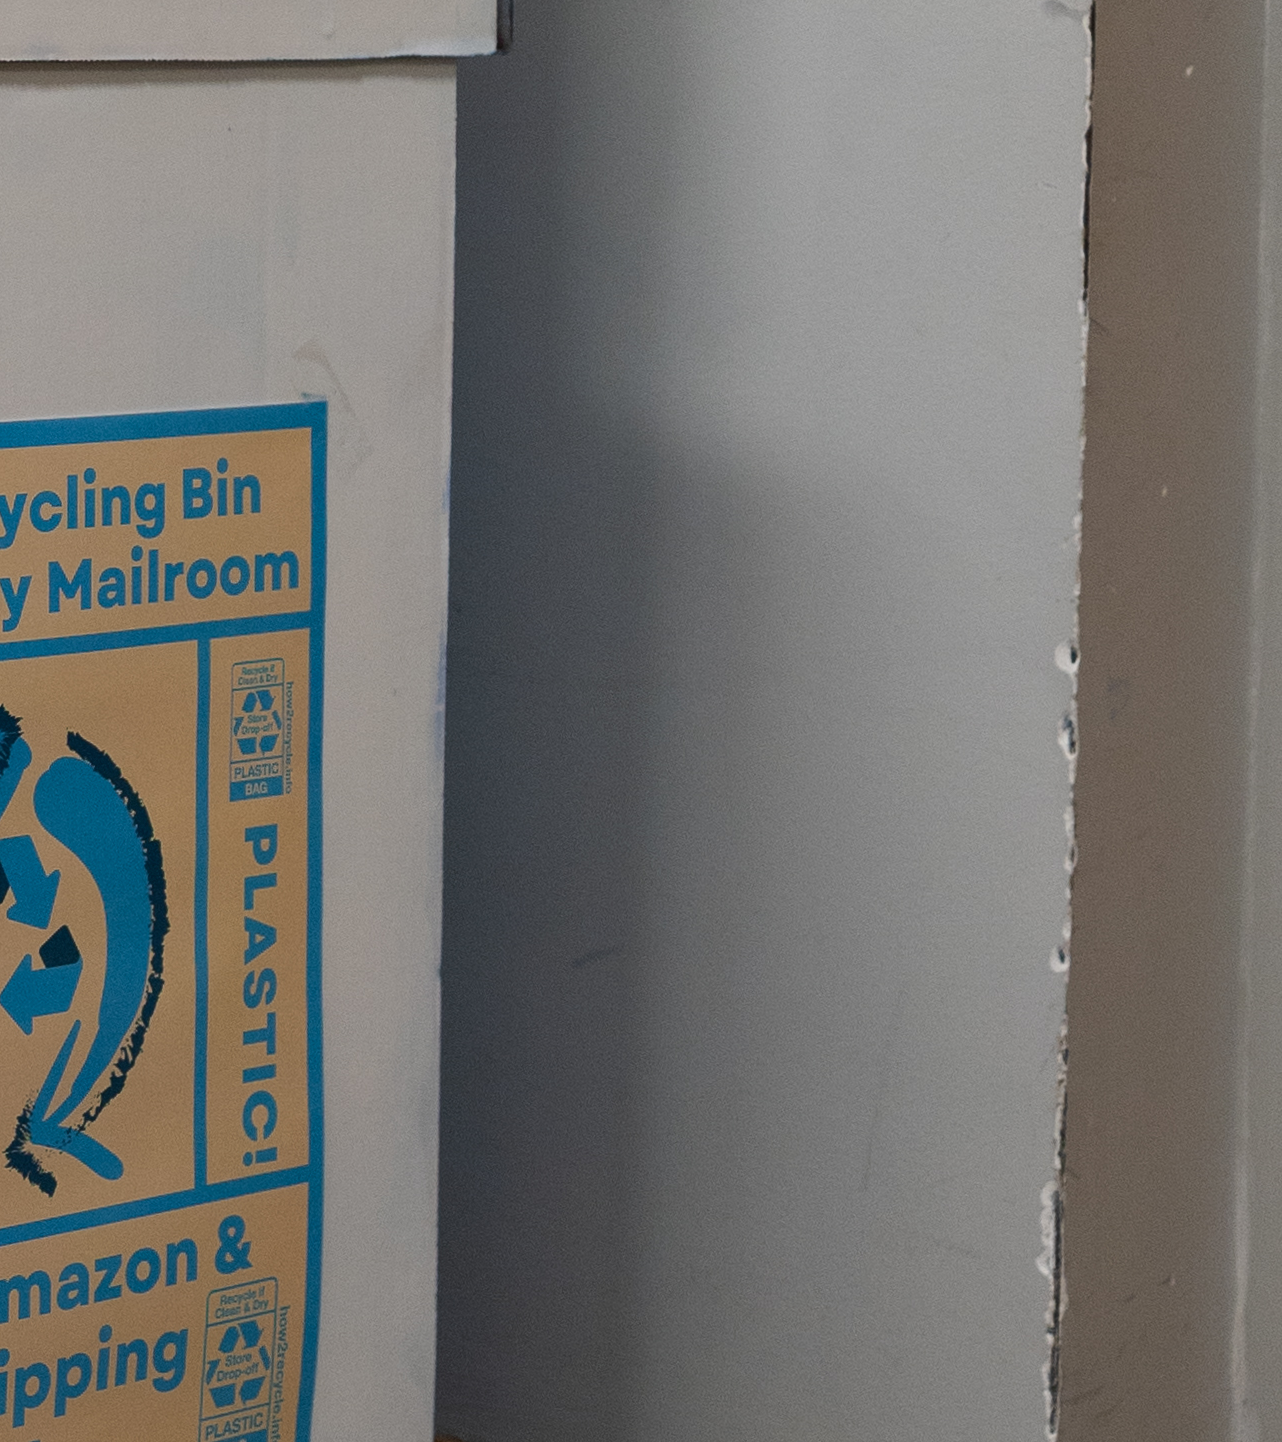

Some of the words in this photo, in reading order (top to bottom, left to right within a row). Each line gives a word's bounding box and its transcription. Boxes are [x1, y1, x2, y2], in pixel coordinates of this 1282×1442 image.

[181, 457, 262, 518] Bin
[48, 546, 301, 615] Mailroom
[235, 762, 279, 779] PLASTIC
[245, 781, 268, 795] BAG
[242, 823, 279, 1168] PLASTIC!
[214, 1215, 253, 1274] &
[205, 1413, 263, 1441] PLASTIC
